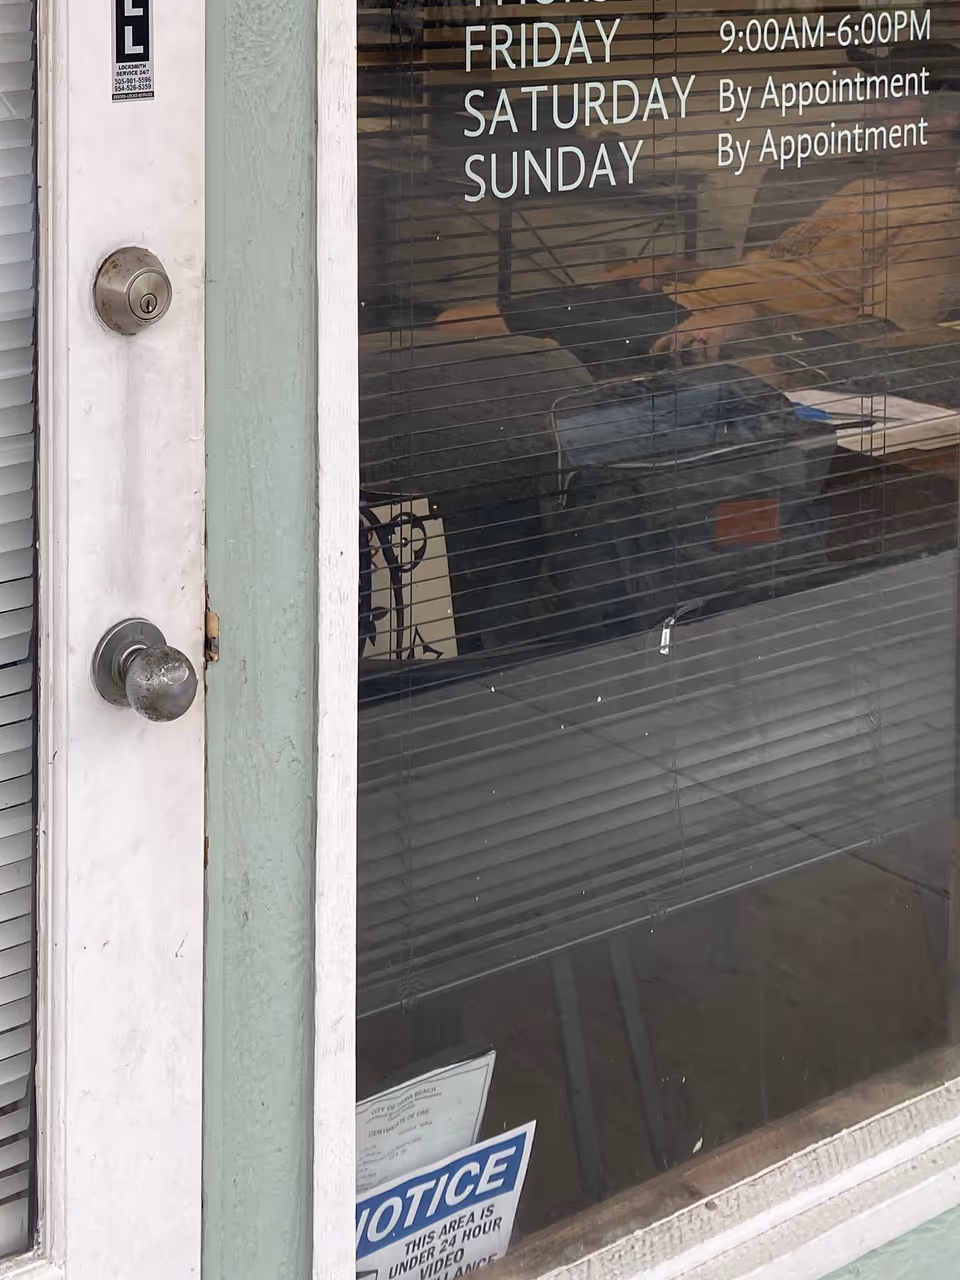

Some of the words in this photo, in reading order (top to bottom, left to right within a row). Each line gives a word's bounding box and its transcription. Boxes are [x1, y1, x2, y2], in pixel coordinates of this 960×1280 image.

[465, 18, 620, 72] FRIDAY
[719, 9, 931, 54] 9:00AM-6:00PM
[464, 75, 695, 138] SATURDAY
[719, 78, 752, 121] By
[761, 67, 930, 117] Appointment
[464, 140, 643, 203] SUNDAY
[717, 133, 750, 175] By
[759, 118, 928, 170] Appointment
[388, 1246, 435, 1279] UNDER
[439, 1234, 457, 1254] 24
[461, 1216, 503, 1243] HOUR
[404, 1230, 435, 1257] THIS
[439, 1211, 476, 1238] AREA
[480, 1204, 495, 1219] IS
[420, 1247, 465, 1280] VIDEO
